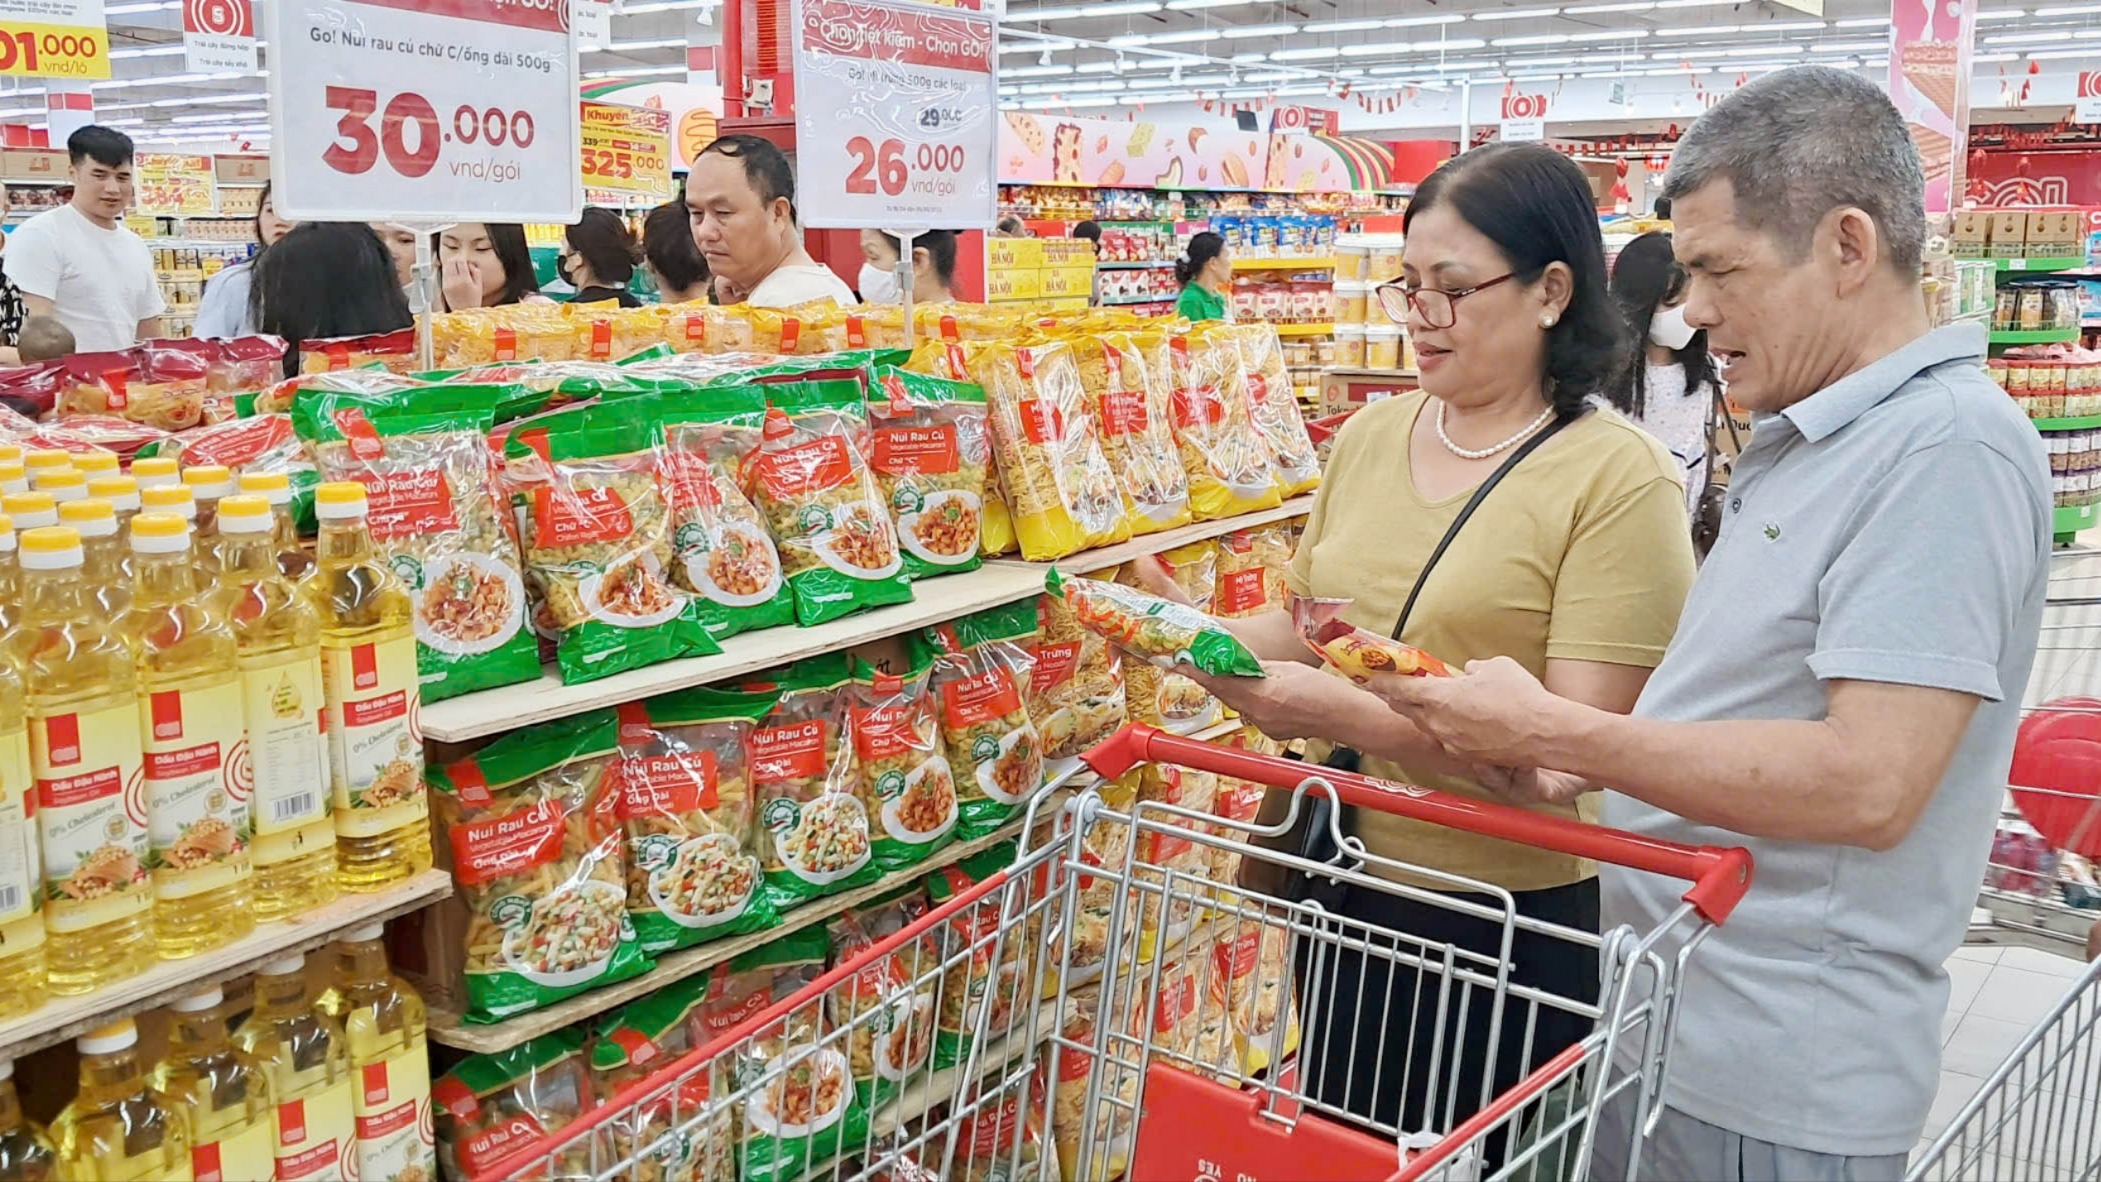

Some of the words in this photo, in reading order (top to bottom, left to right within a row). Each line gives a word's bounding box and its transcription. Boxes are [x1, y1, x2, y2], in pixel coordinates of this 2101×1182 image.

[310, 27, 337, 44] Go!
[371, 38, 394, 51] rau
[397, 37, 414, 53] củ
[418, 42, 444, 57] chữ
[493, 51, 513, 66] dài
[516, 54, 551, 73] 500g
[925, 35, 958, 58] Chọn
[933, 79, 948, 88] các
[321, 85, 535, 178] 30.000
[449, 158, 521, 183] vnd/gói
[845, 136, 965, 197] 26.000
[911, 179, 956, 197] vnd/gói
[890, 432, 908, 443] Nui
[911, 432, 929, 442] Rau
[753, 732, 774, 745] Nui
[778, 729, 800, 742] Rau
[652, 759, 678, 773] Rau
[468, 825, 494, 843] Nui
[498, 817, 524, 835] Rau
[1198, 1159, 1221, 1178] YES
